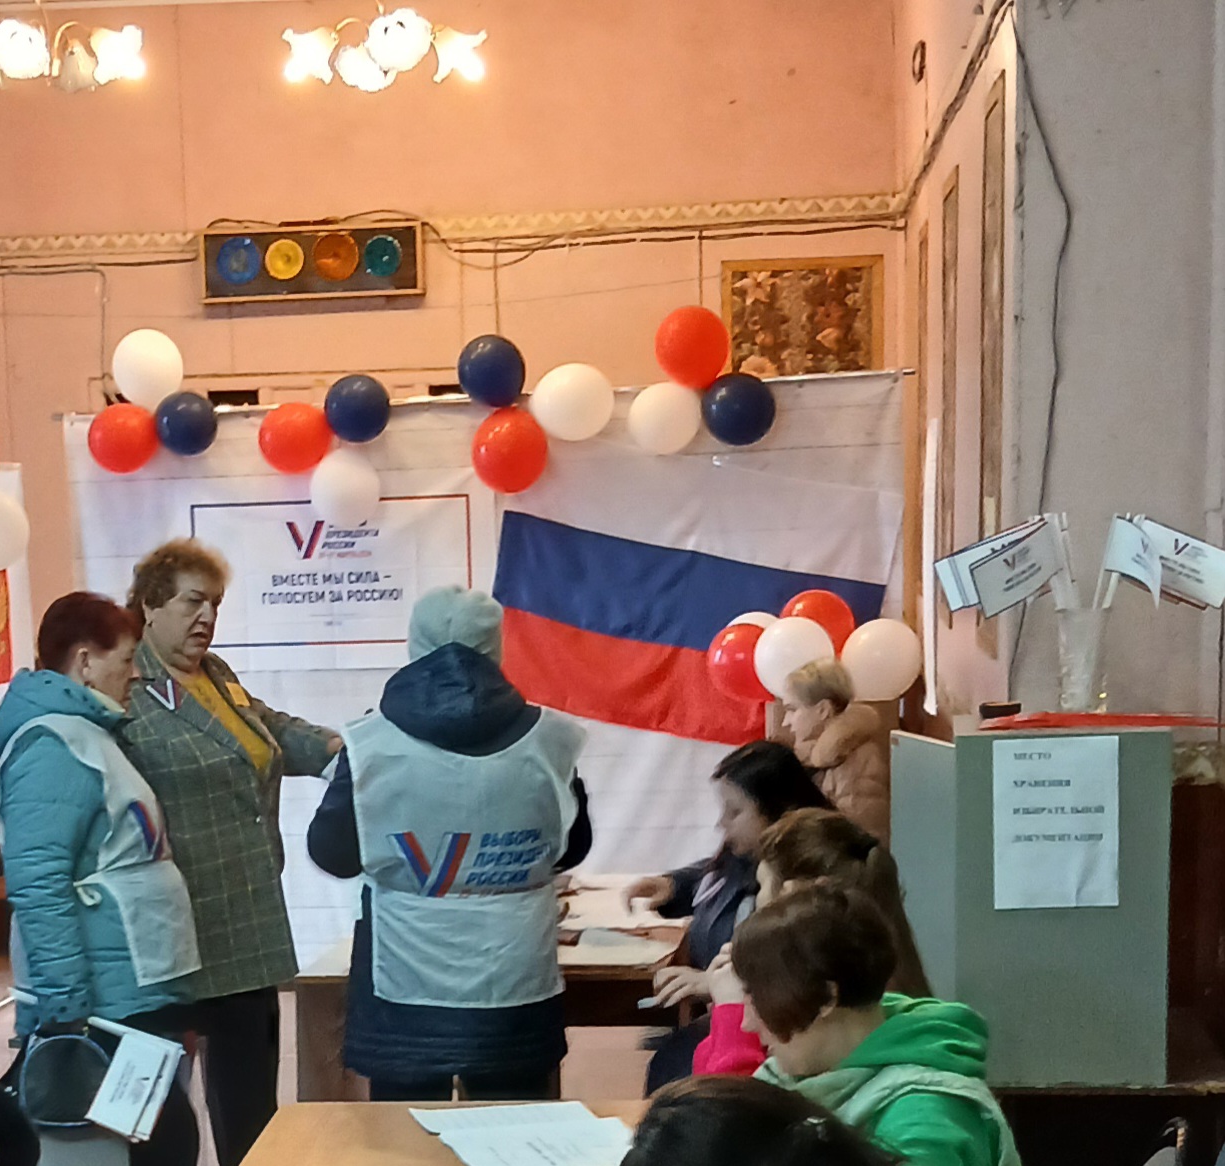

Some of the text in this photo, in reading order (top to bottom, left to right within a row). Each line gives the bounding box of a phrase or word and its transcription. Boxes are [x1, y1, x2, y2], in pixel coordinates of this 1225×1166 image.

[272, 573, 318, 587] ВМЕСТЕ
[323, 573, 344, 584] МЫ
[348, 571, 380, 584] СИЛА
[262, 589, 403, 604] ГОЛОСУЕМ ЗА РОССИЮ!
[465, 868, 531, 887] РОССИИ
